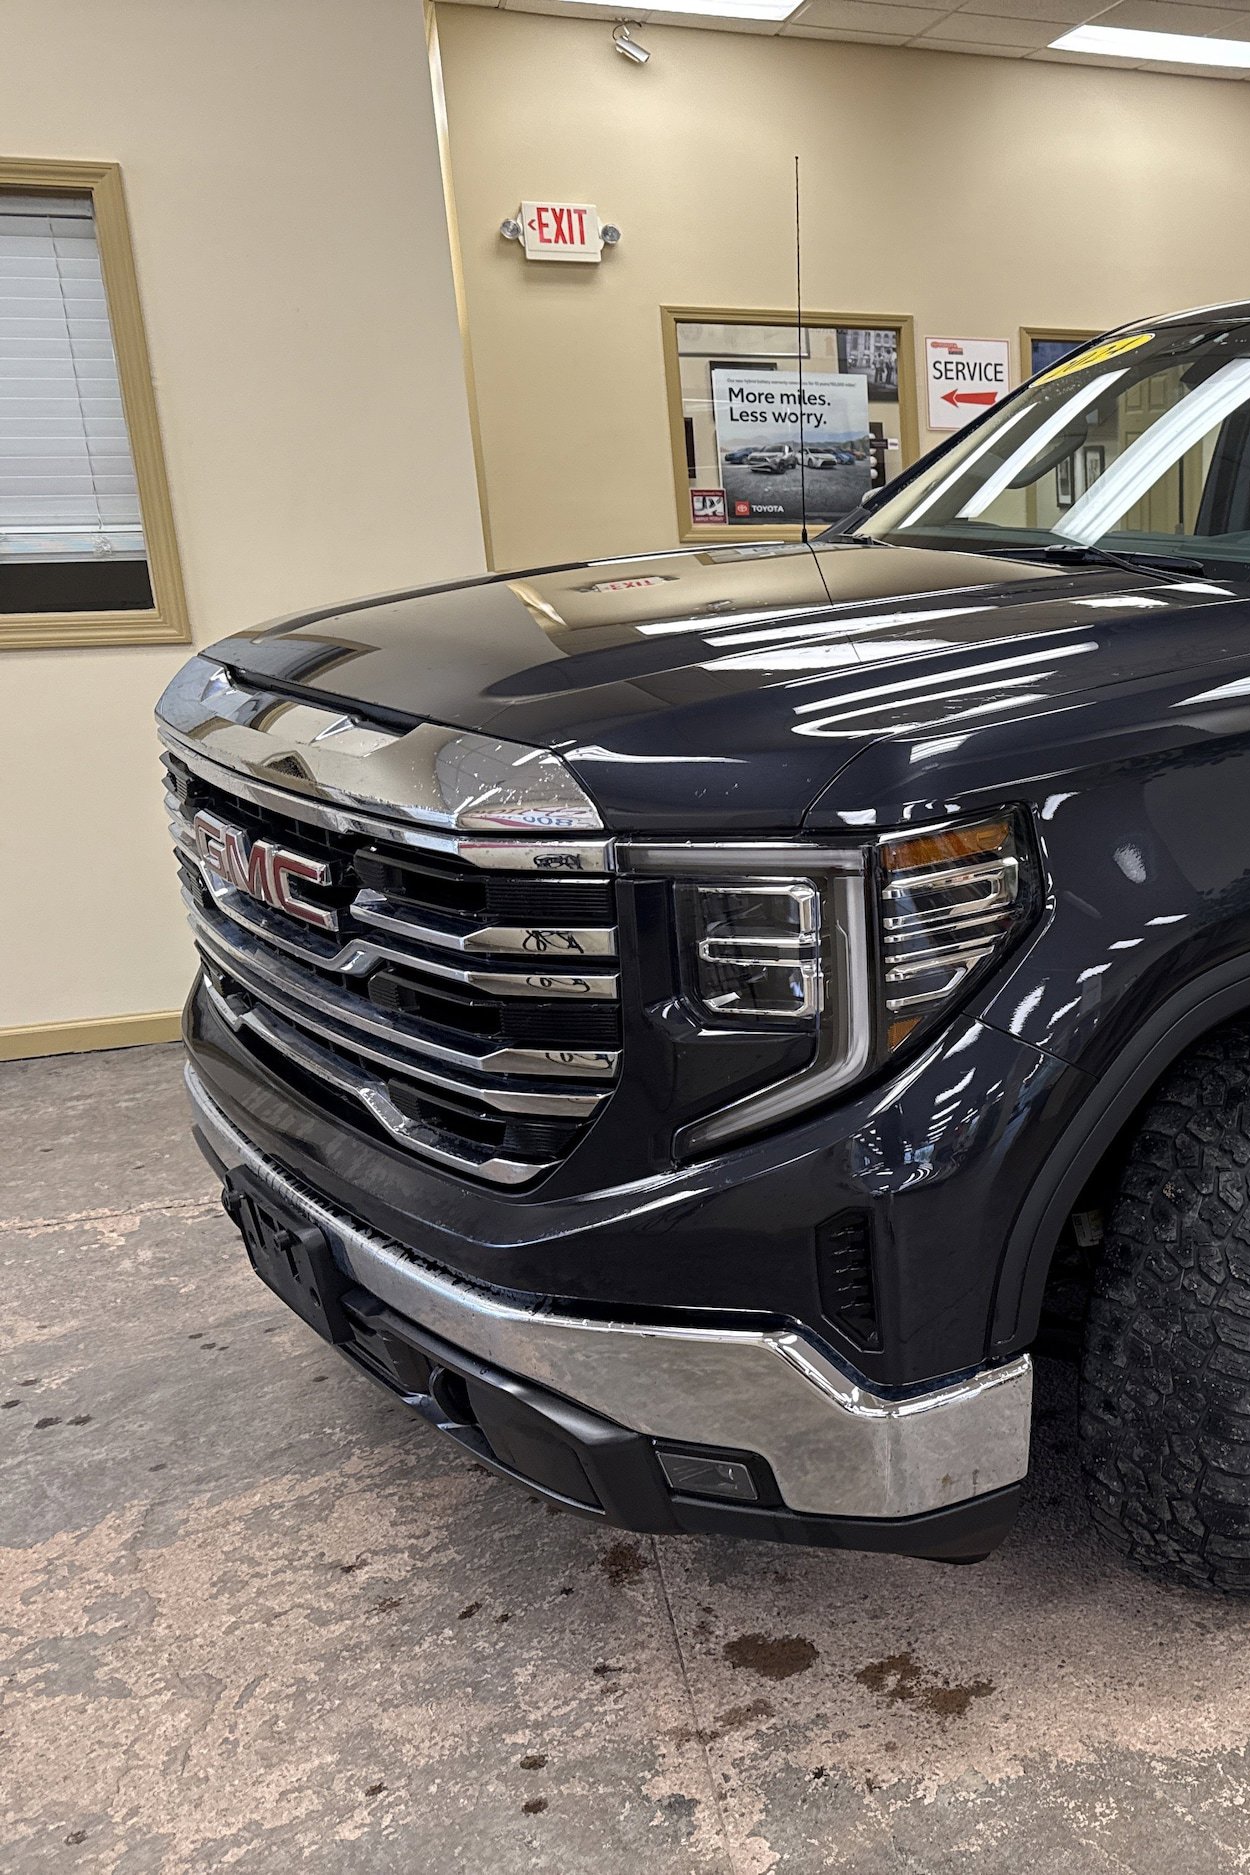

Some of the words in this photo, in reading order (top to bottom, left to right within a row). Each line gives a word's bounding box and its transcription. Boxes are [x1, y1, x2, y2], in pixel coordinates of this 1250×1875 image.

[536, 207, 587, 245] EXIT
[932, 360, 1005, 382] SERVICE
[728, 387, 775, 404] More
[780, 388, 831, 406] miles.
[730, 406, 768, 422] Less
[772, 409, 827, 428] worry.
[751, 505, 785, 513] TOYOTA
[194, 809, 340, 932] GMC
